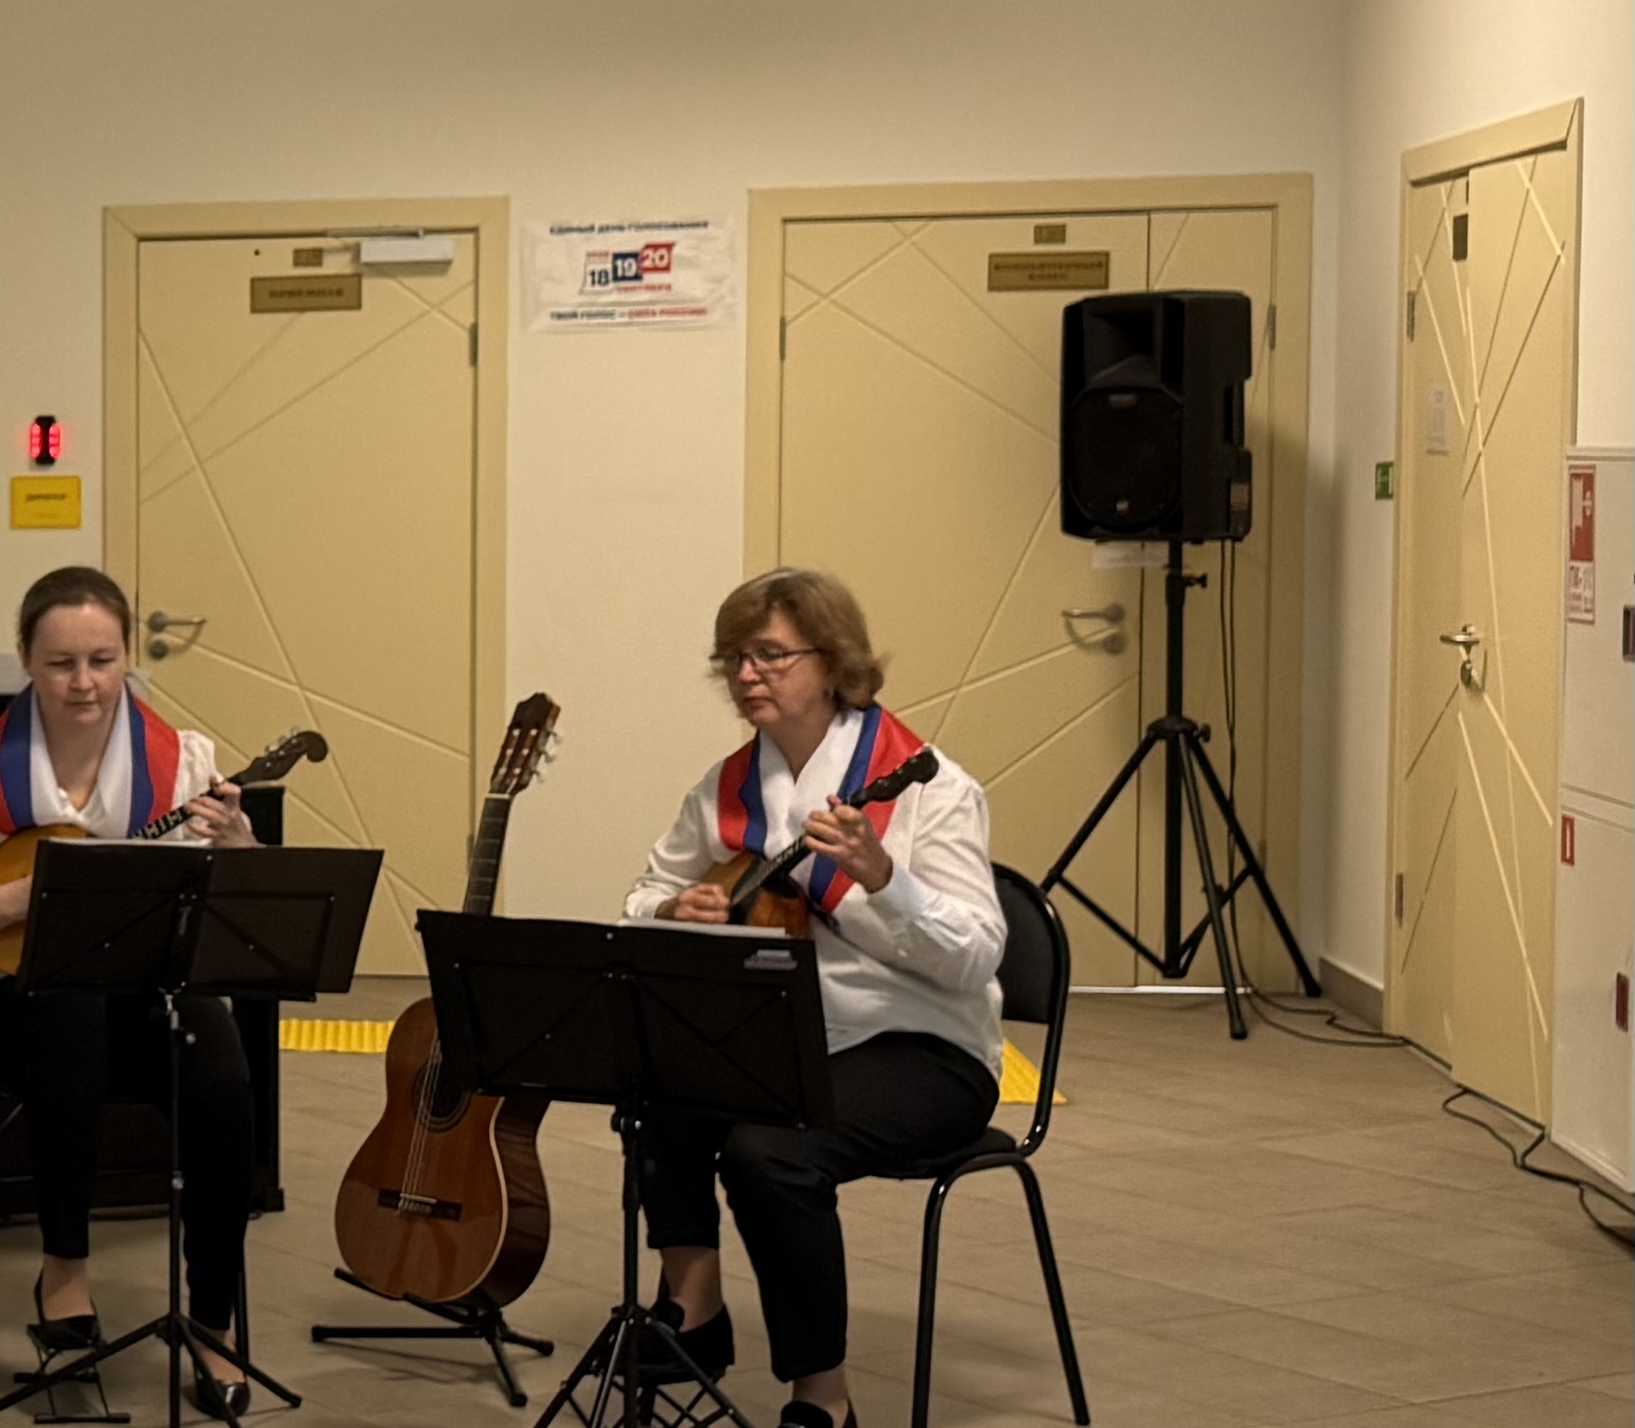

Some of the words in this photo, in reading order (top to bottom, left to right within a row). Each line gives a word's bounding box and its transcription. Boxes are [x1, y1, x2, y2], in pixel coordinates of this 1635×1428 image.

[589, 269, 610, 287] 18
[616, 257, 638, 278] 19
[641, 247, 669, 269] 20
